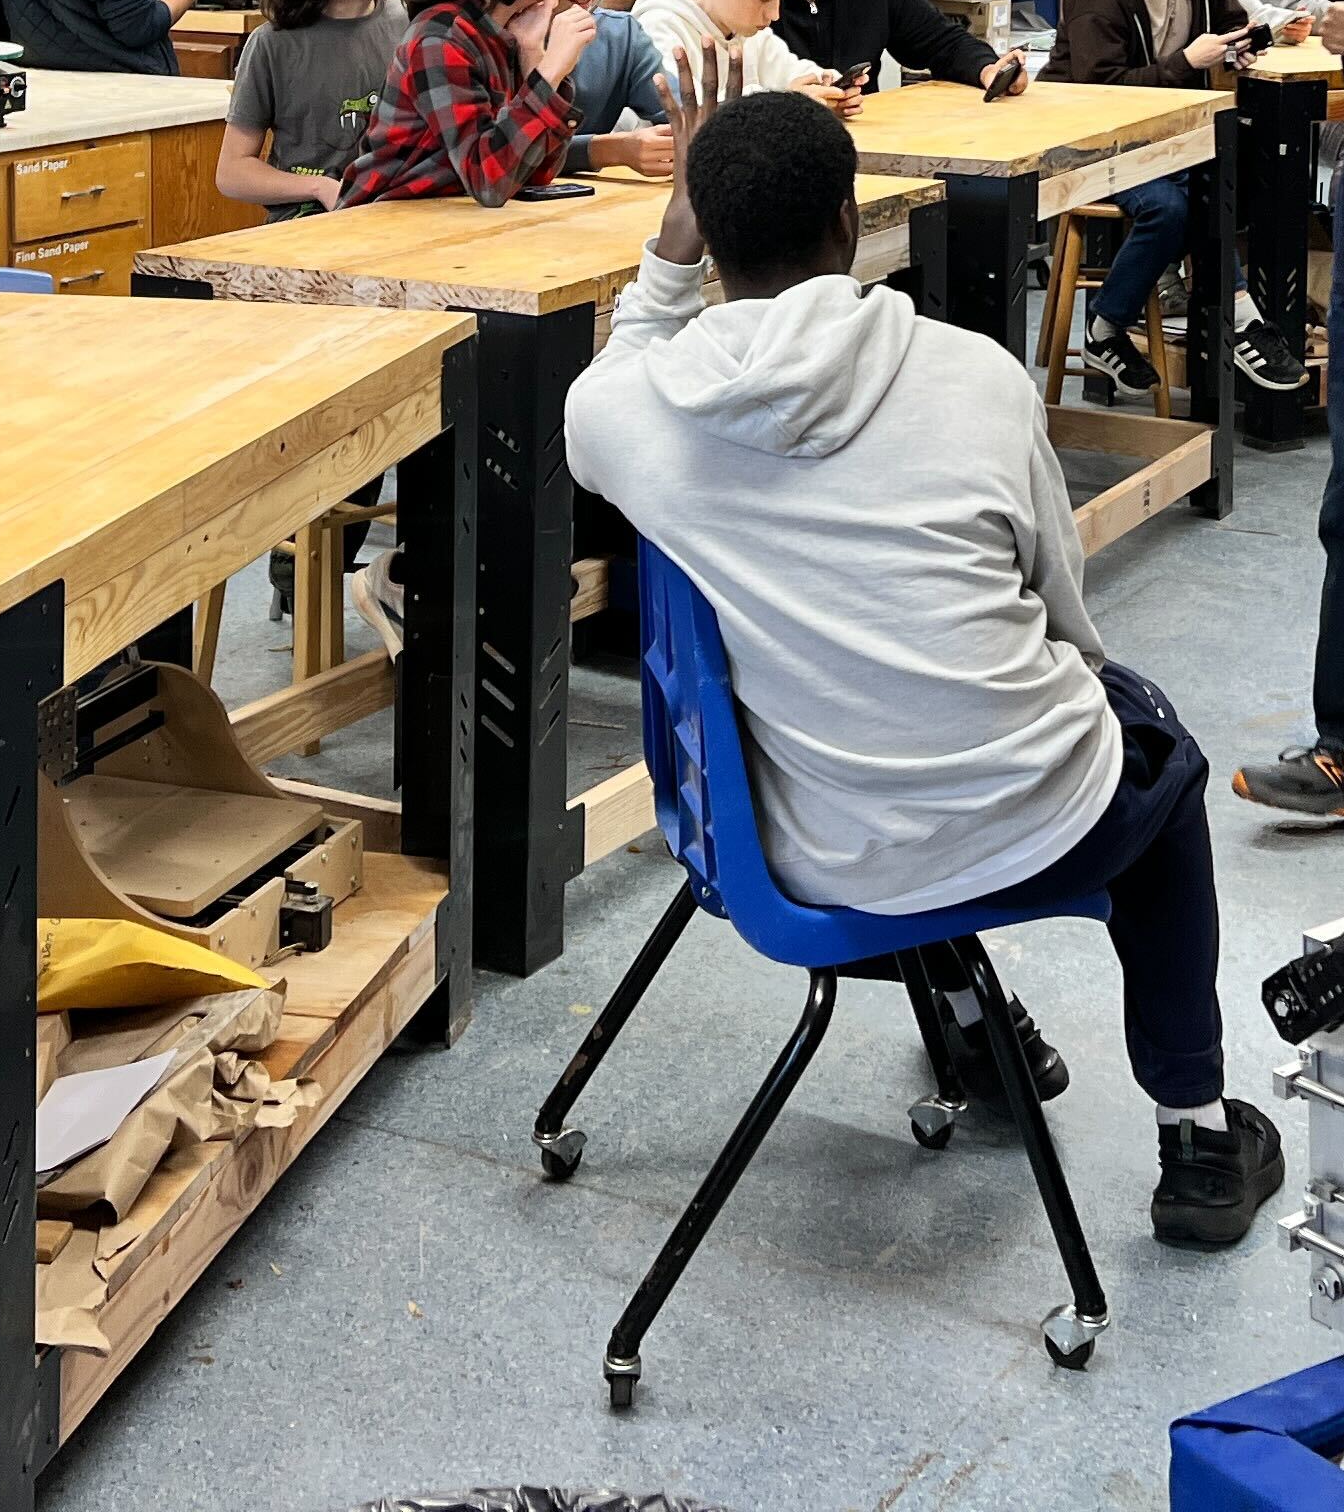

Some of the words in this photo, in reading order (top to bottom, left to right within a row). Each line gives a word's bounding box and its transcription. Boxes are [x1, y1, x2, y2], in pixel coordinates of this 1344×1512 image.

[16, 162, 40, 176] Sand
[42, 159, 69, 173] Paper
[15, 251, 36, 263] Fine
[38, 244, 62, 259] Sand
[63, 240, 89, 254] Paper
